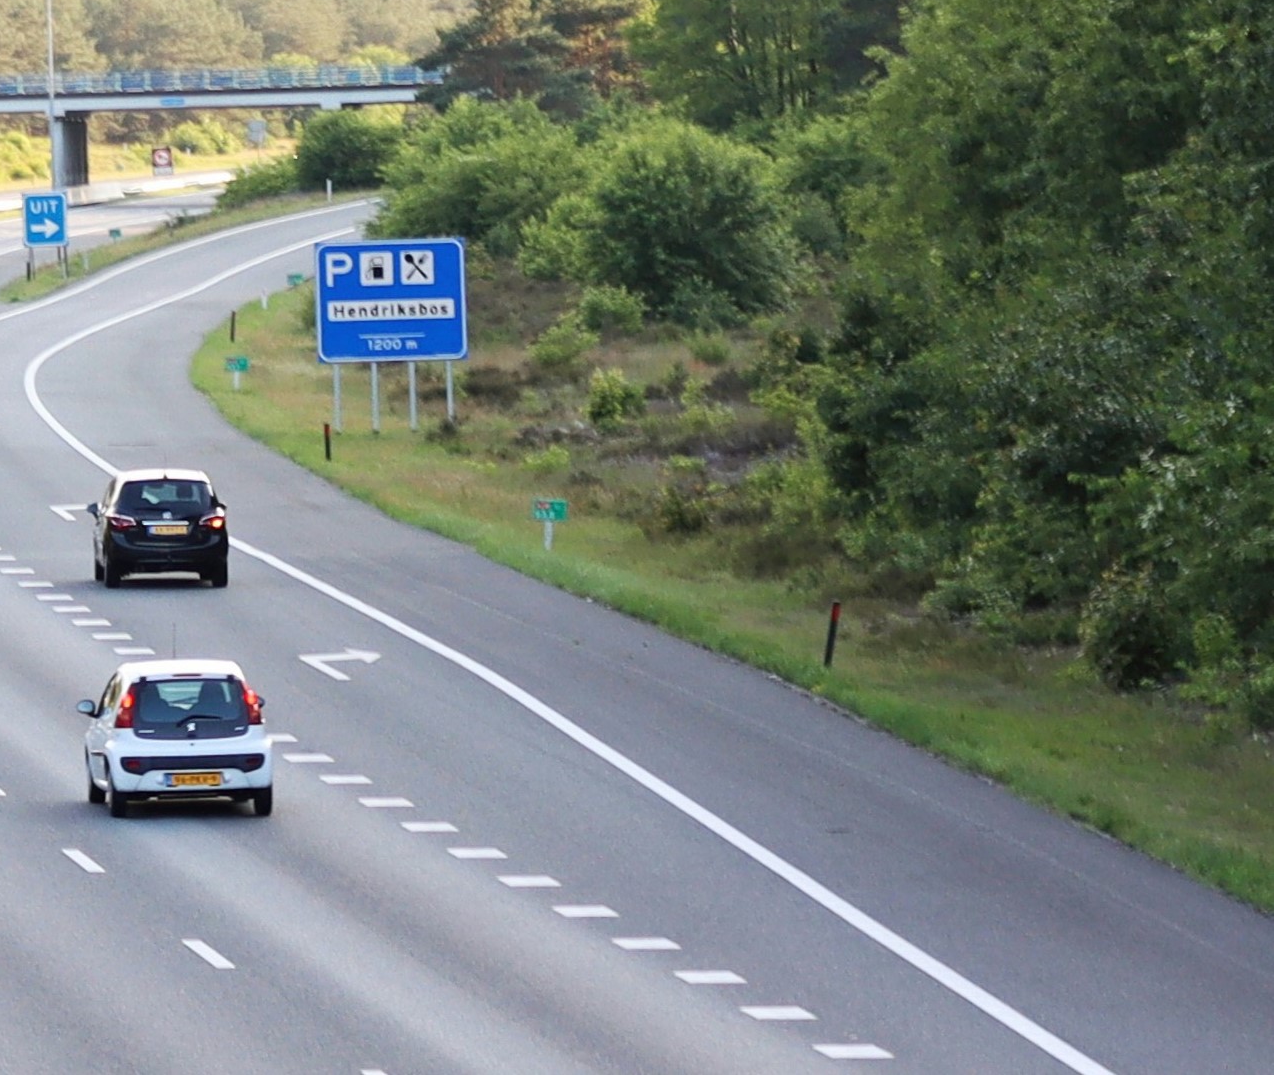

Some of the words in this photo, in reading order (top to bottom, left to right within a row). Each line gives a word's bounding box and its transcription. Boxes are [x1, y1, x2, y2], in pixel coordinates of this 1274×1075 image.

[29, 199, 58, 214] UIT
[325, 253, 353, 287] P
[333, 303, 449, 318] Hendriksbos
[367, 338, 402, 351] 1200
[405, 339, 418, 350] m
